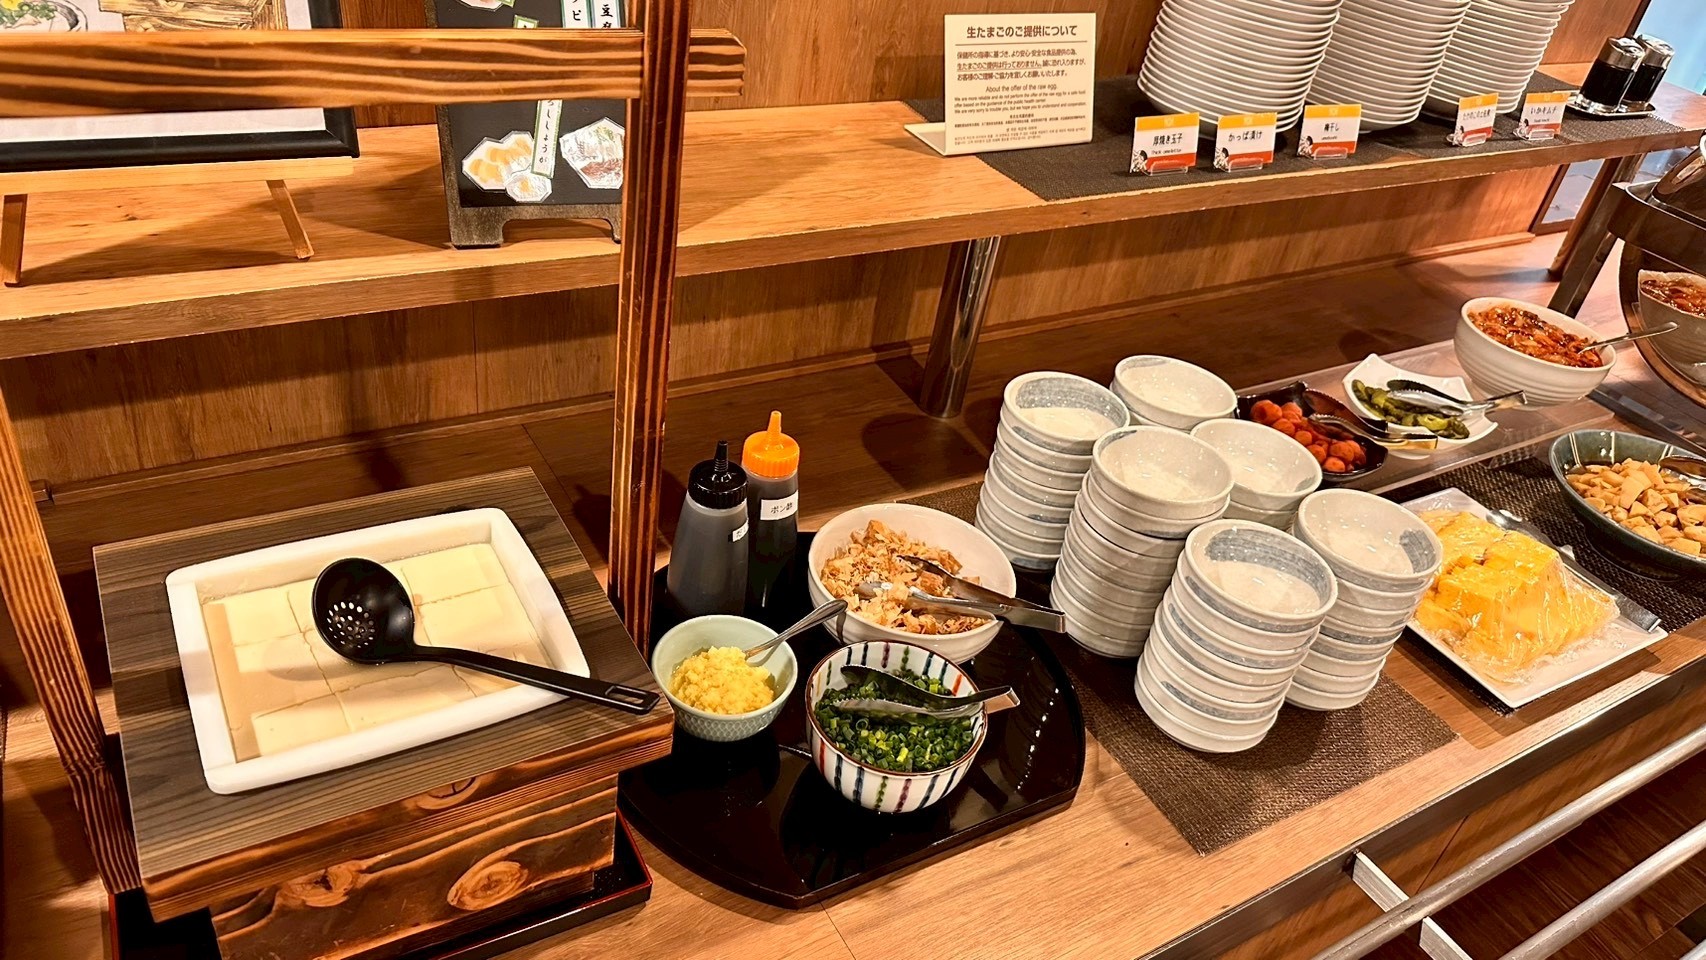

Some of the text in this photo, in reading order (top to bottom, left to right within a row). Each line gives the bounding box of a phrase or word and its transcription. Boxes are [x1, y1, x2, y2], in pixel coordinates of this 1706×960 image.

[966, 25, 1078, 38] 生たまごのご提供について
[1324, 122, 1339, 131] 梅干し
[1153, 132, 1183, 146] 厚焼き玉子
